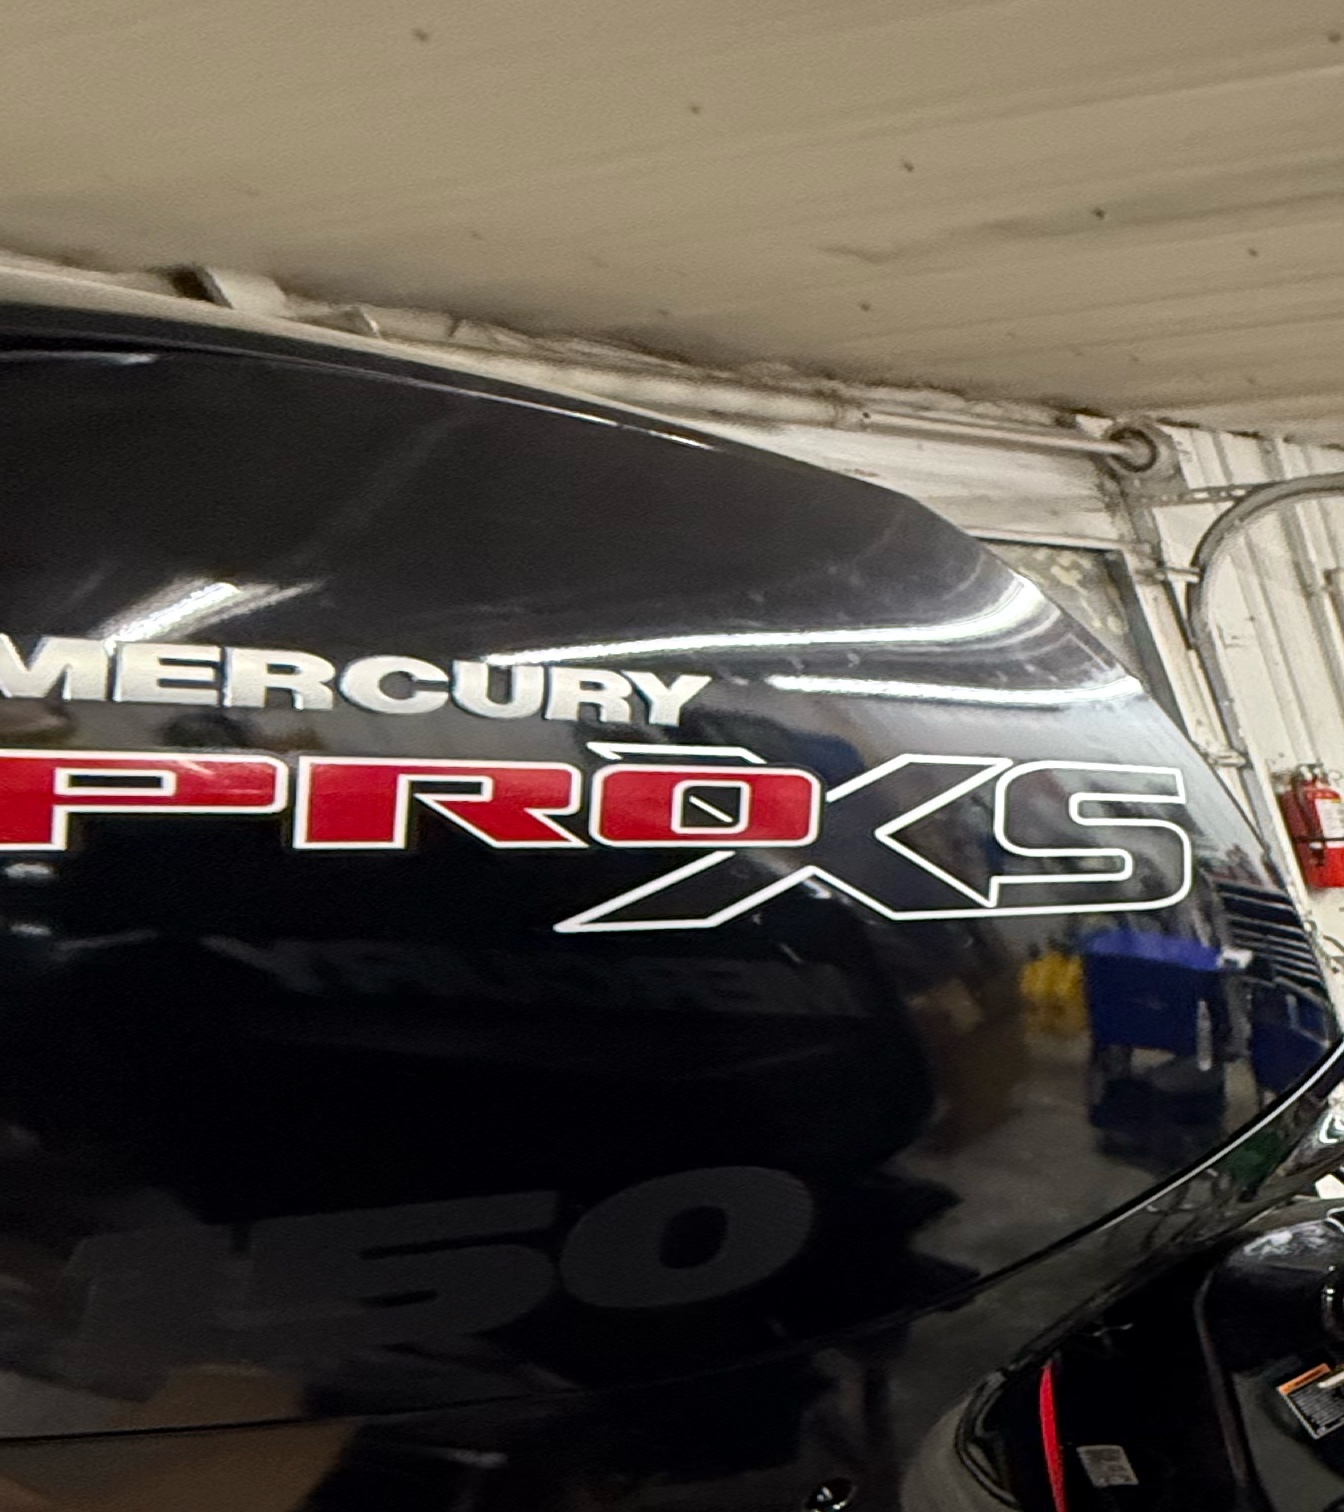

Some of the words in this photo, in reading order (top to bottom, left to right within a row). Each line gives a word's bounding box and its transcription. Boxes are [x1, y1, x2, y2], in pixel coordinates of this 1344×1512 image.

[0, 633, 711, 727] MERCURY
[0, 747, 821, 851] PRO
[553, 742, 1192, 933] XS
